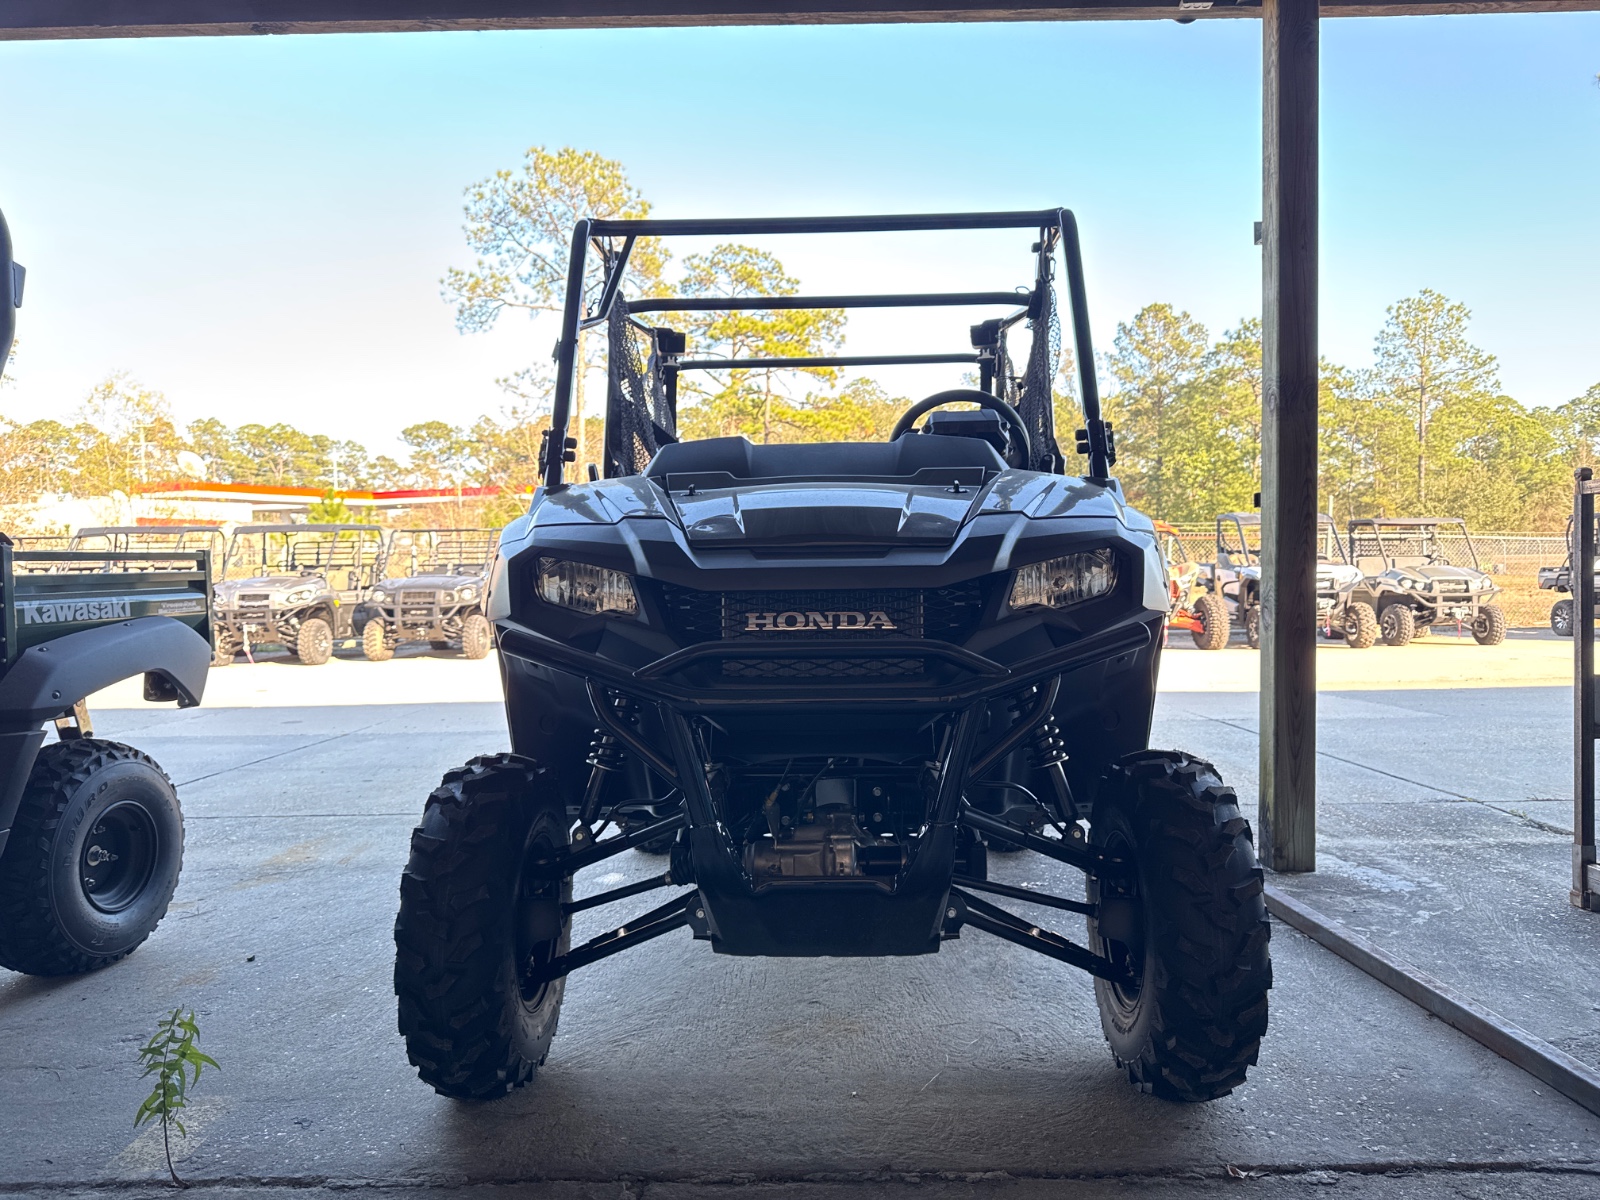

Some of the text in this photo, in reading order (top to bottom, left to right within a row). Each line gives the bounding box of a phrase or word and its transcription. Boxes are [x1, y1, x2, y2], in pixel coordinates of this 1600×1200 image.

[23, 597, 131, 625] Kawasaki
[744, 611, 898, 631] HONDA
[65, 781, 109, 849] DURO
